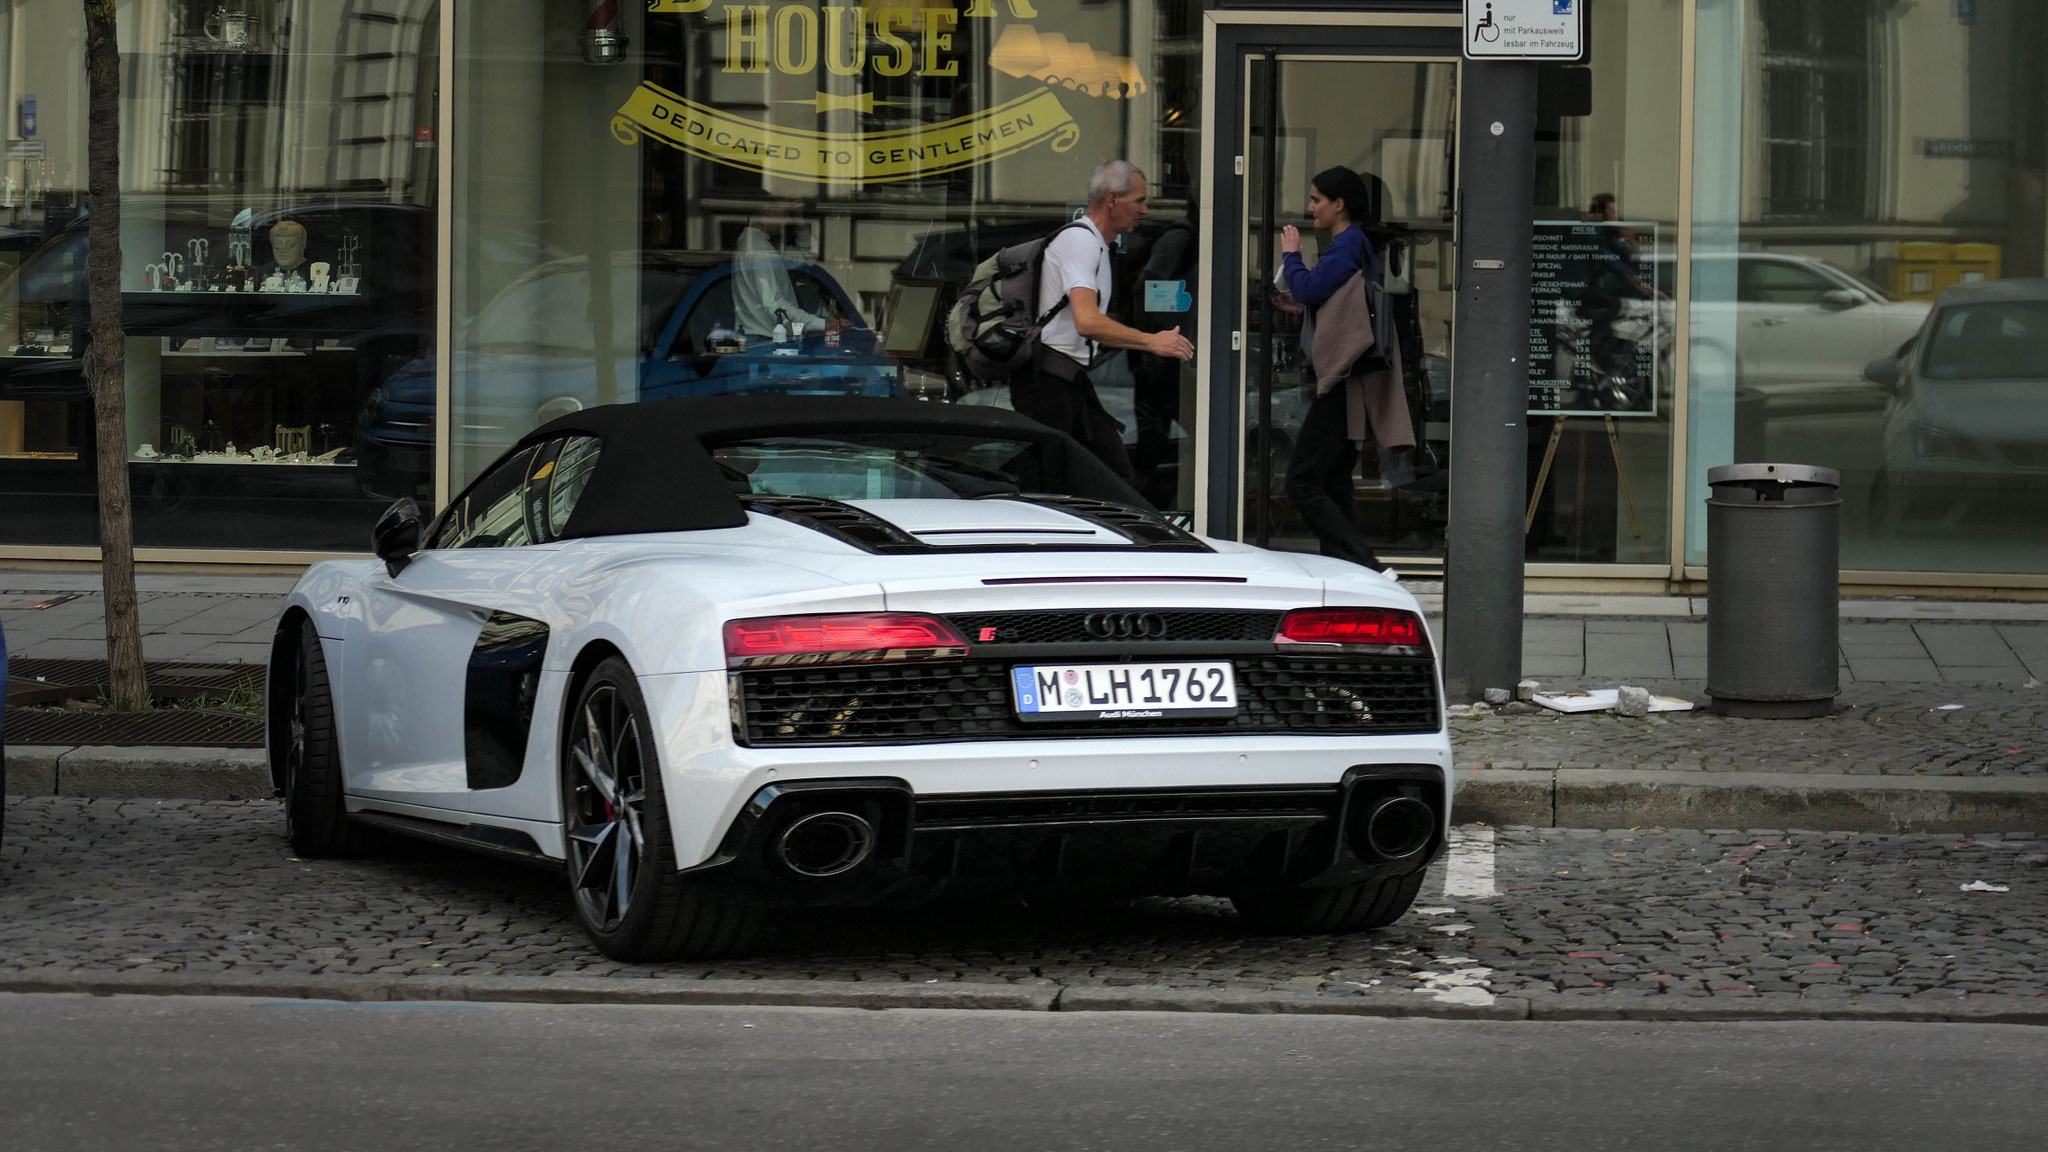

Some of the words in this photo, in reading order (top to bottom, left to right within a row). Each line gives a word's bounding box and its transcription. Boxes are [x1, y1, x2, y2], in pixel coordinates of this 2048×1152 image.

[1518, 26, 1564, 34] Parkausweis
[722, 4, 958, 76] HOUSE
[1541, 40, 1574, 49] Fahrzeug
[652, 104, 800, 160] DEDICATED
[818, 150, 851, 165] TO
[869, 114, 1034, 164] GENTLEMEN
[1038, 671, 1062, 706] M
[1141, 668, 1228, 703] 1762
[1024, 695, 1033, 705] D
[1099, 711, 1121, 719] Audi
[1122, 710, 1162, 718] München
